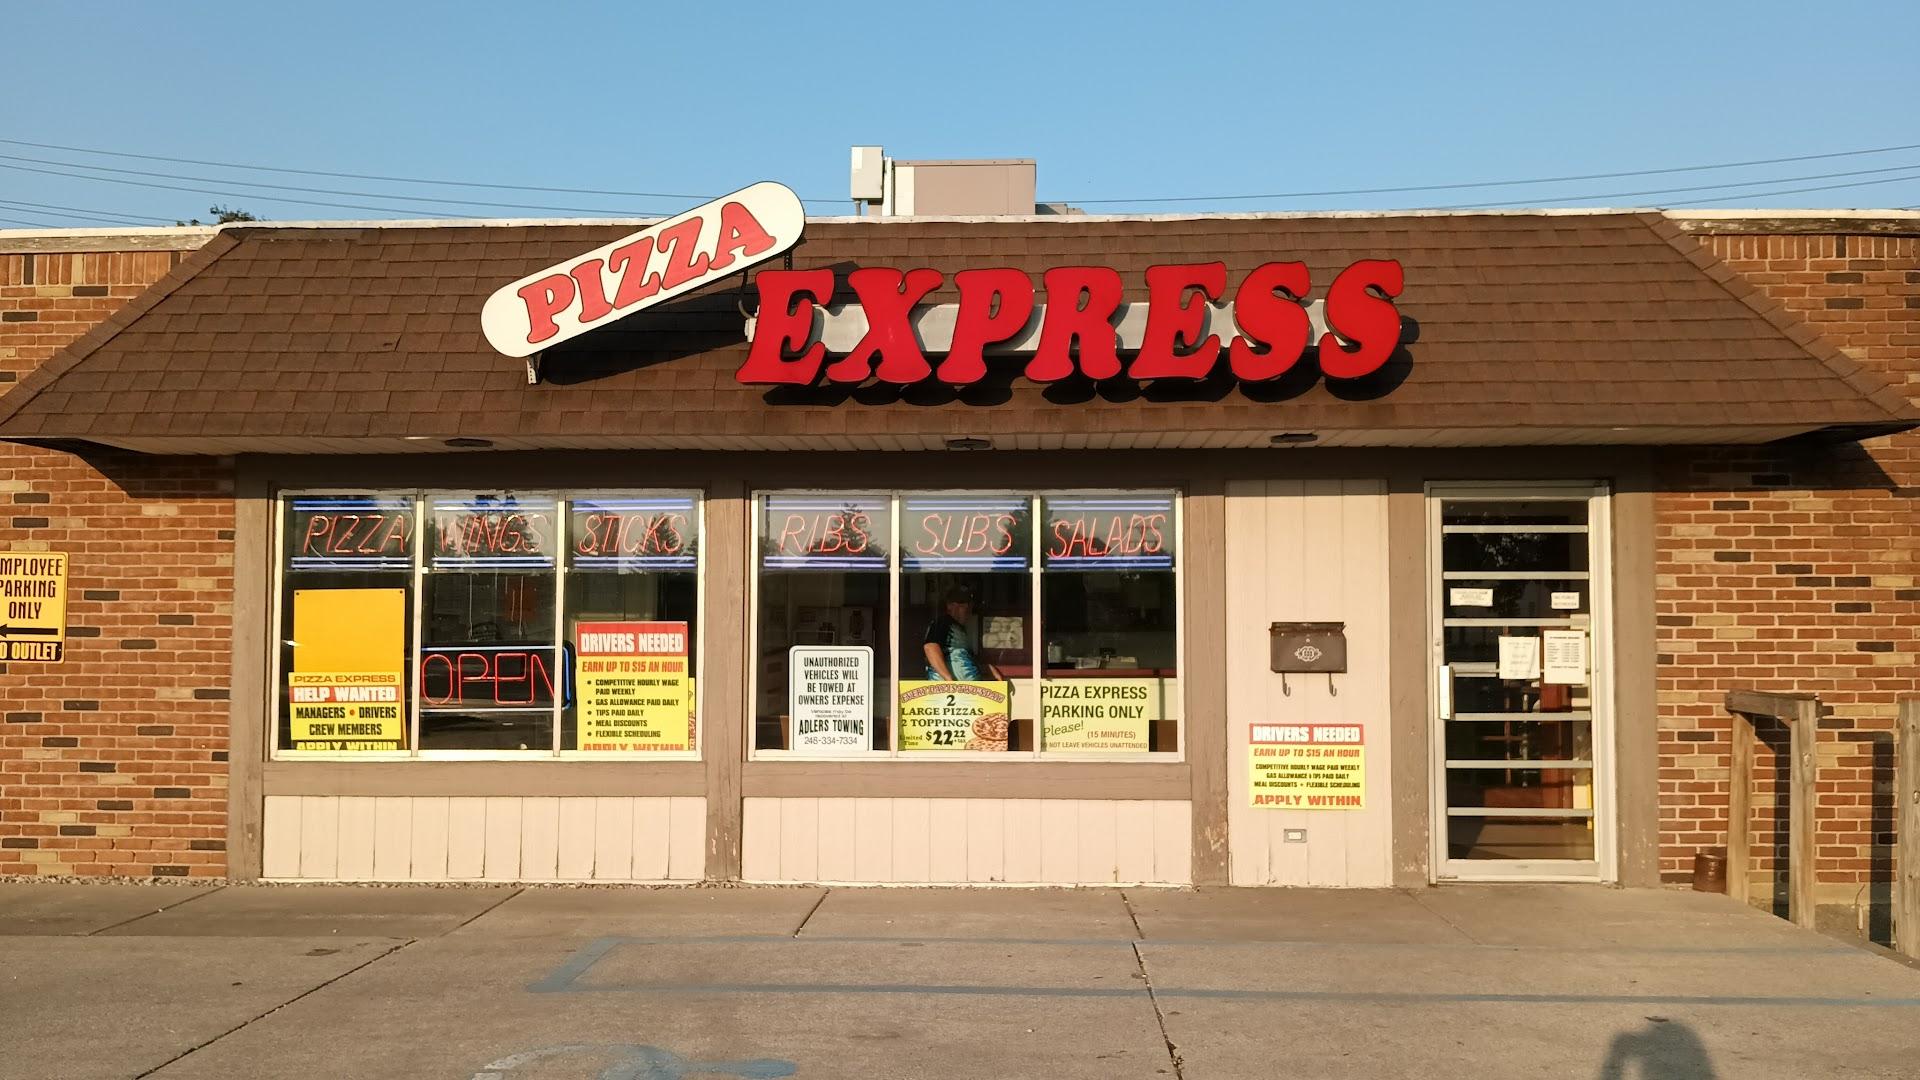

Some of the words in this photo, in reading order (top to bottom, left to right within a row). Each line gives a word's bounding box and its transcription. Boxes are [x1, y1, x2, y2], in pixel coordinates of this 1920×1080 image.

[518, 201, 777, 344] PIZZA
[735, 260, 1404, 385] EXPRESS
[303, 515, 404, 553] PIZZA
[440, 513, 547, 553] WINGS
[579, 514, 687, 553] STICKS
[781, 514, 872, 553] RIBS
[916, 513, 1017, 553] SUBS
[1050, 513, 1167, 557] SALADS
[0, 558, 62, 576] MPLOYEE
[9, 602, 41, 619] ONLY
[0, 642, 7, 659] O
[12, 642, 57, 660] OUTLET
[581, 633, 635, 653] DRIVERS
[639, 633, 684, 653] NEEDED
[582, 661, 604, 672] EARN
[606, 661, 617, 672] UP
[620, 661, 630, 672] TO
[632, 661, 646, 673] $15
[648, 661, 661, 672] AN
[662, 661, 684, 672] HOUR
[803, 657, 859, 667] UNAUTHORIZED
[421, 653, 556, 705] OPEN
[804, 670, 839, 680] VEHICLES
[842, 670, 858, 680] WILL
[294, 687, 330, 702] HELP
[334, 686, 397, 702] WANTED
[807, 683, 816, 692] BE
[819, 683, 844, 692] TOWED
[847, 683, 856, 692] AT
[1041, 686, 1080, 699] PIZZA
[1084, 686, 1147, 699] EXPRESS
[798, 695, 829, 705] OWNERS
[832, 695, 864, 705] EXPENSE
[946, 694, 956, 706] 2
[296, 707, 346, 718] MANAGERS
[359, 706, 397, 718] DRIVERS
[1043, 705, 1104, 718] PARKING
[1109, 706, 1144, 718] ONLY
[309, 724, 335, 735] CREW
[338, 724, 382, 735] MEMBERS
[798, 720, 829, 735] ADLERS
[833, 720, 864, 735] TOWING
[902, 719, 907, 727] 2
[911, 719, 970, 727] TOPPINGS
[1043, 720, 1084, 738] Please!
[1087, 731, 1098, 739] (15
[1100, 731, 1136, 739] MINUTES)
[1252, 726, 1309, 742] DRIVERS
[1313, 727, 1360, 742] NEEDED
[1254, 748, 1276, 756] EARN
[1279, 749, 1290, 757] UP
[1293, 749, 1303, 757] TO
[1306, 749, 1321, 757] $15
[1323, 749, 1335, 757] AN
[1337, 749, 1360, 757] HOUR
[1254, 795, 1302, 805] APPLY
[1307, 795, 1361, 806] WITHIN
